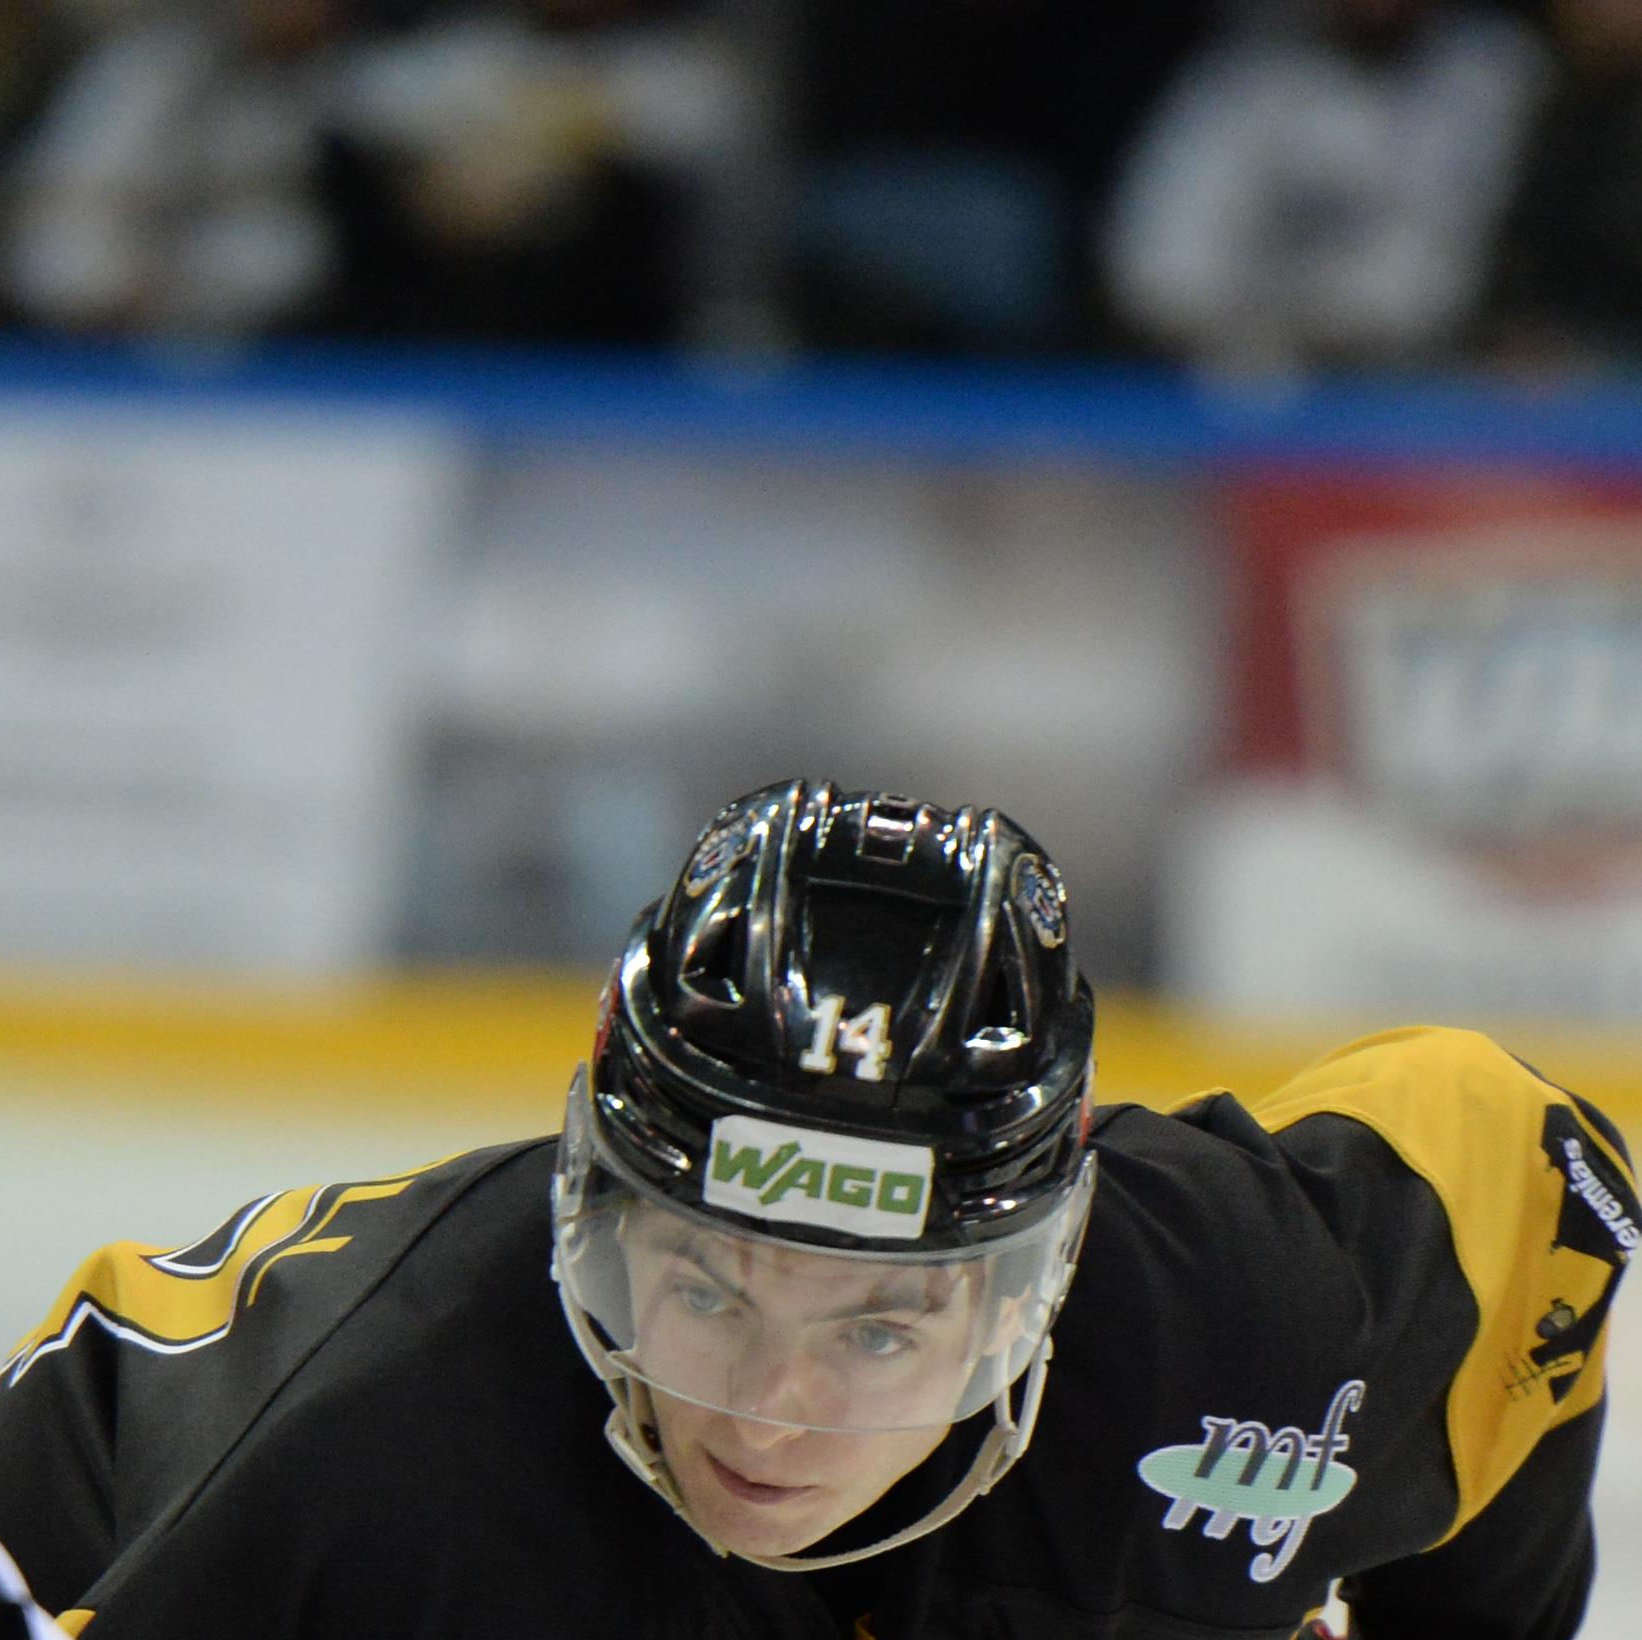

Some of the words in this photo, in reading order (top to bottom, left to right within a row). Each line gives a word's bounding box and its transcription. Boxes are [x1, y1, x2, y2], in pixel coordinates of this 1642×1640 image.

[799, 994, 894, 1082] 14
[712, 1139, 925, 1215] WAGO
[1562, 1137, 1641, 1254] eremias
